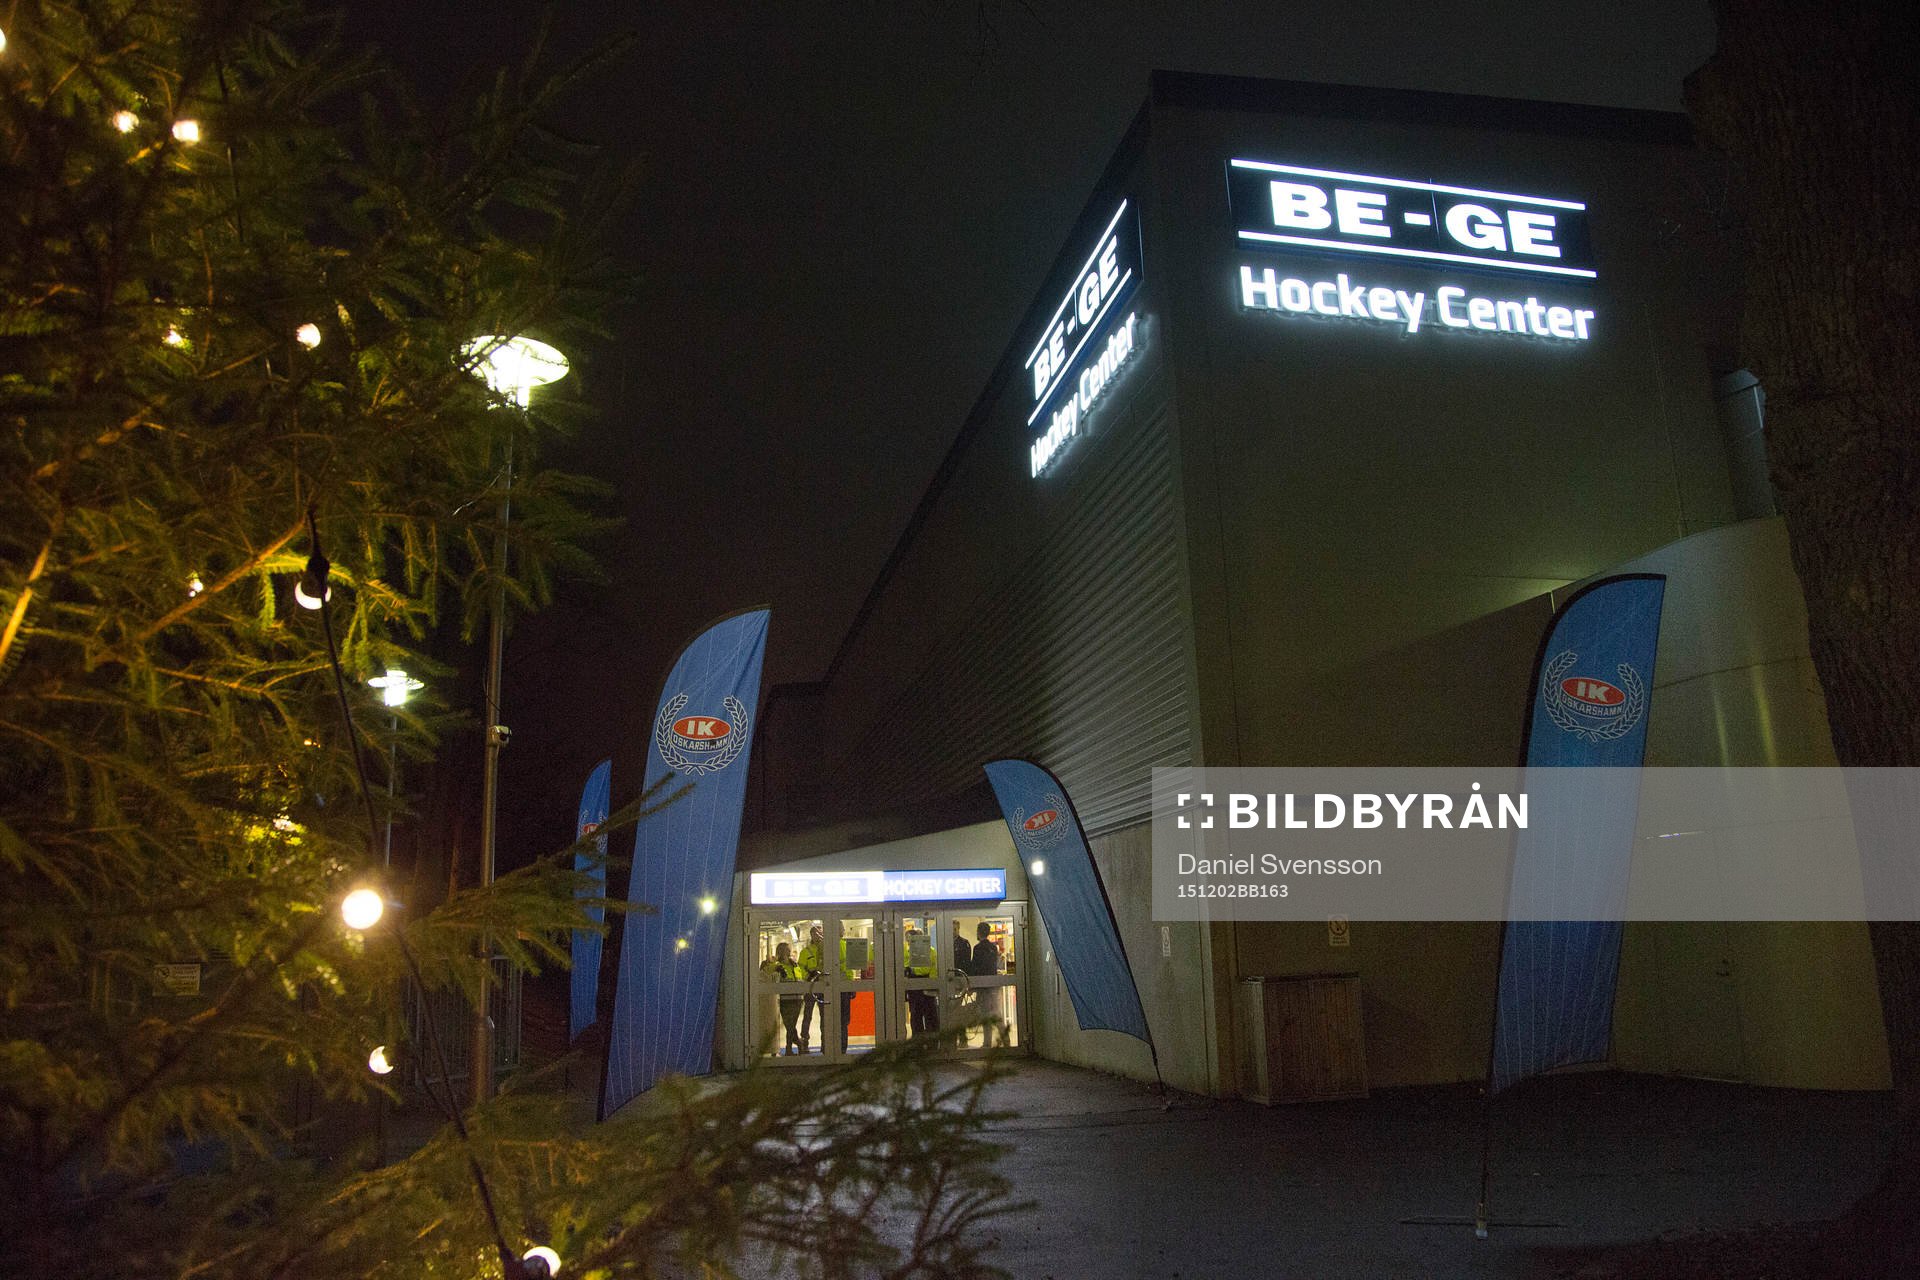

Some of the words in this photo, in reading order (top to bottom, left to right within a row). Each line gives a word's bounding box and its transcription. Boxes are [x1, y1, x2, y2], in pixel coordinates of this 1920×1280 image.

[1239, 265, 1425, 333] Hockey
[1436, 285, 1595, 340] Center
[1031, 391, 1078, 479] Hockey
[1079, 311, 1135, 411] Center
[1576, 681, 1610, 703] IK
[1561, 694, 1623, 716] OSKARSHAMN
[686, 720, 716, 736] IK
[885, 878, 942, 896] HOCKEY
[945, 877, 1002, 894] CENTER
